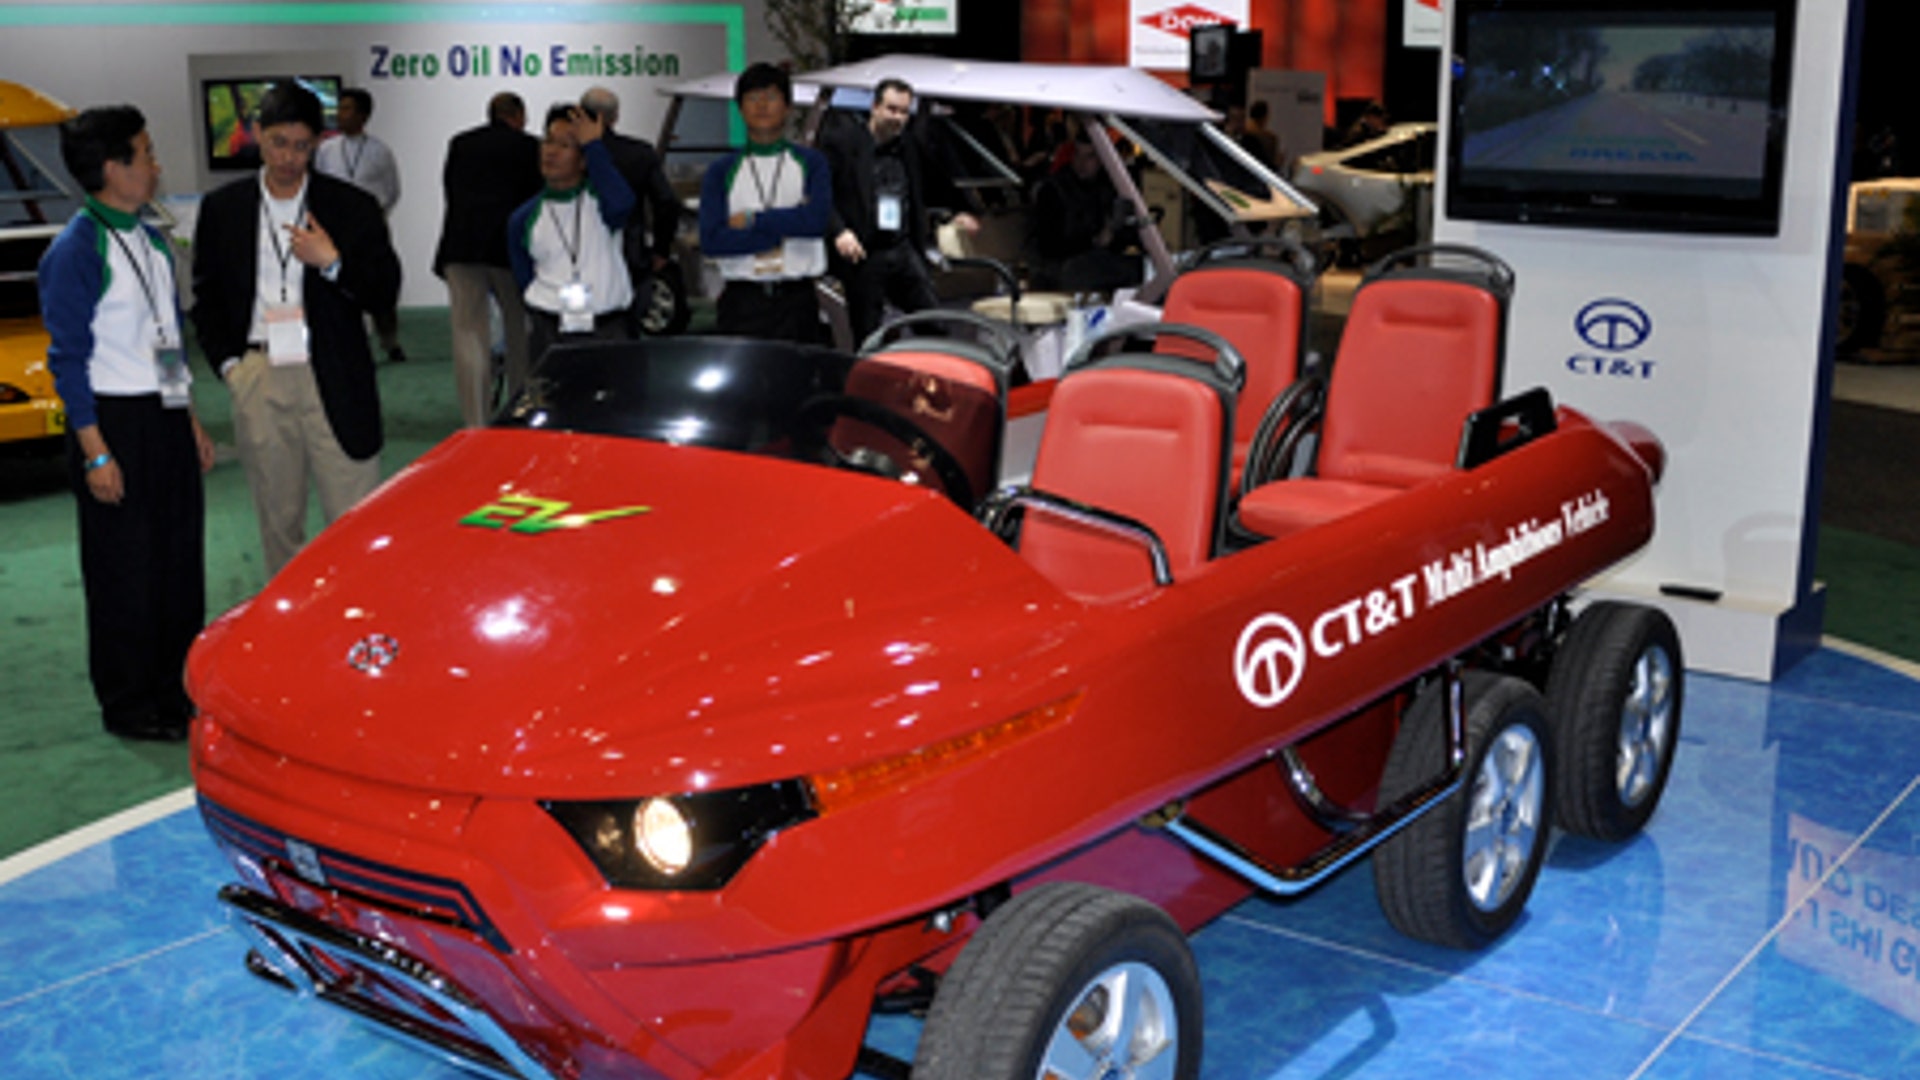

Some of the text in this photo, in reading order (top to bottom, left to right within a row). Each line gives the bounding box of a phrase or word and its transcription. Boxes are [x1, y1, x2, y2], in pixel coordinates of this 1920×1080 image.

[370, 45, 680, 77] Zero Oil No Emission
[1565, 354, 1658, 379] CT&T
[1310, 573, 1418, 657] CT&T
